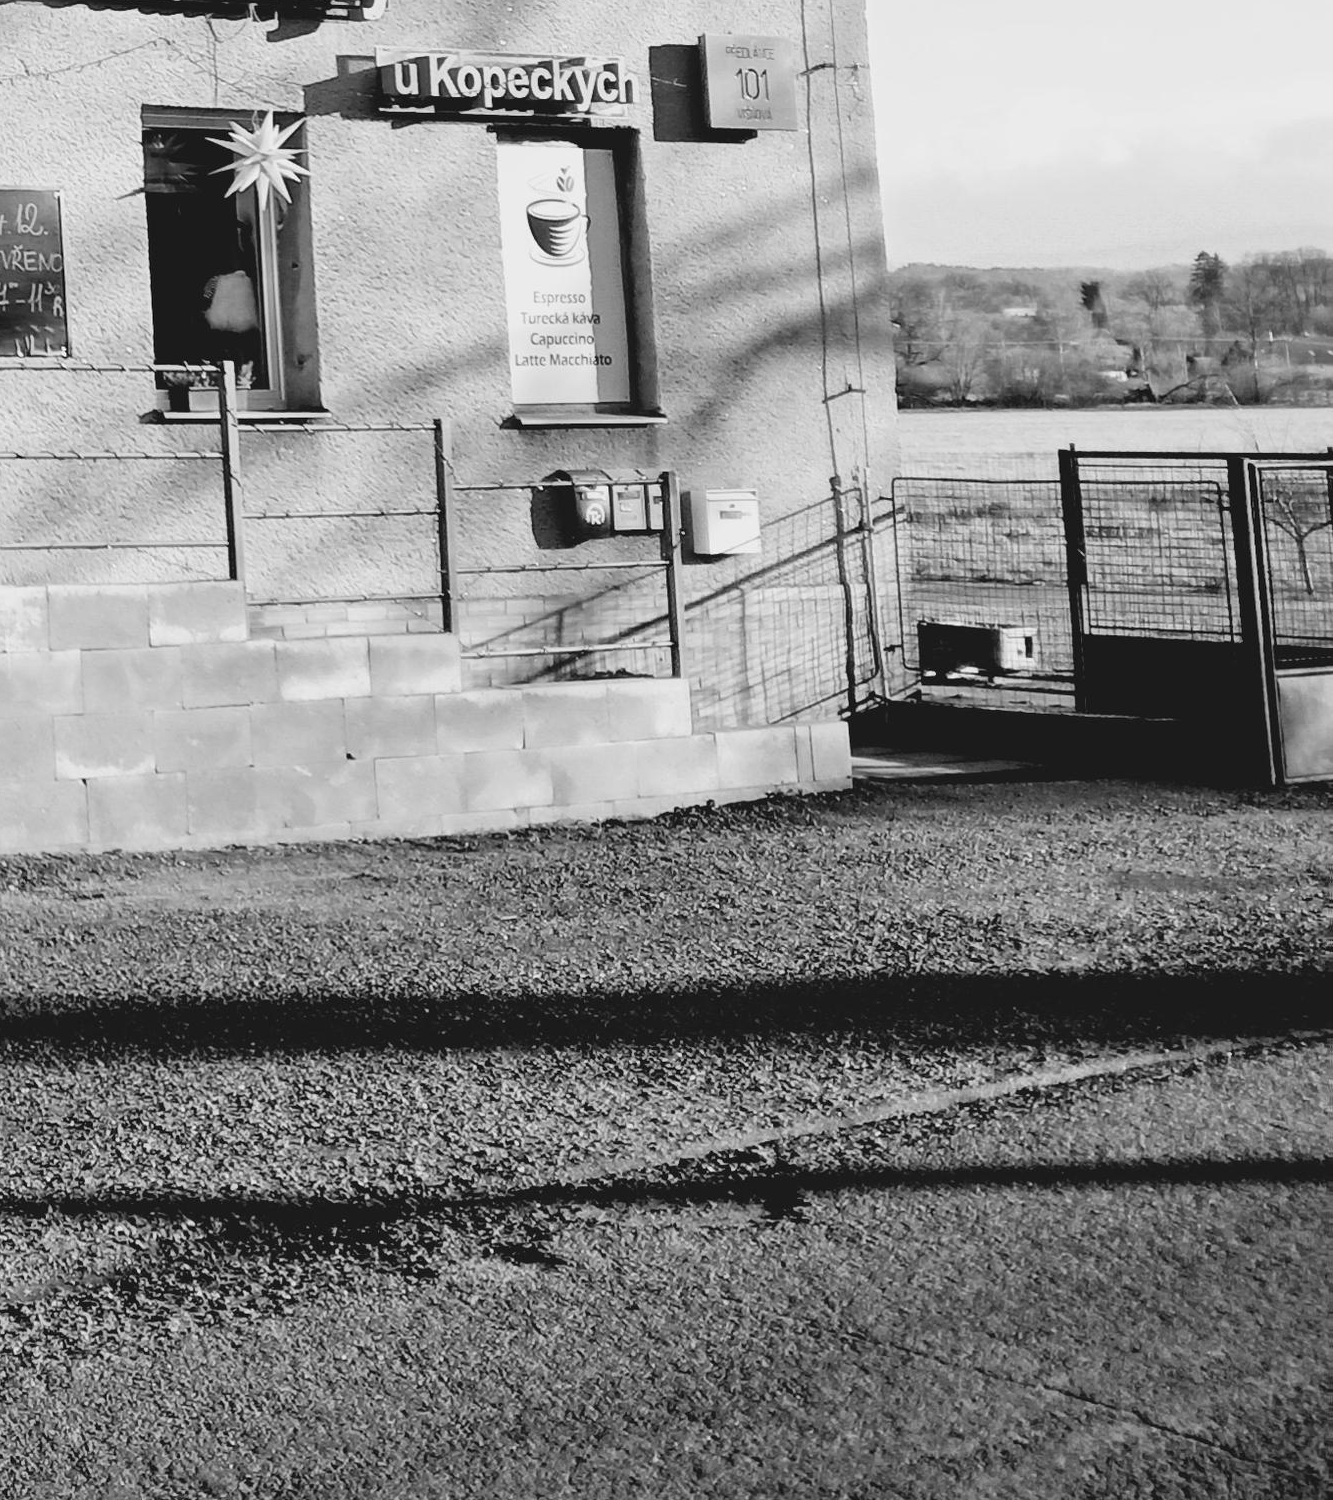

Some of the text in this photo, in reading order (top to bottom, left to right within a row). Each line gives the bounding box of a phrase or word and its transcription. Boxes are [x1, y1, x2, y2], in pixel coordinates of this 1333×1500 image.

[394, 63, 419, 95] u
[735, 68, 770, 101] 101
[533, 291, 586, 307] Espresso
[520, 311, 601, 325] Turecká káva
[530, 332, 595, 349] Capuccino
[515, 353, 613, 367] Latte Macchiato
